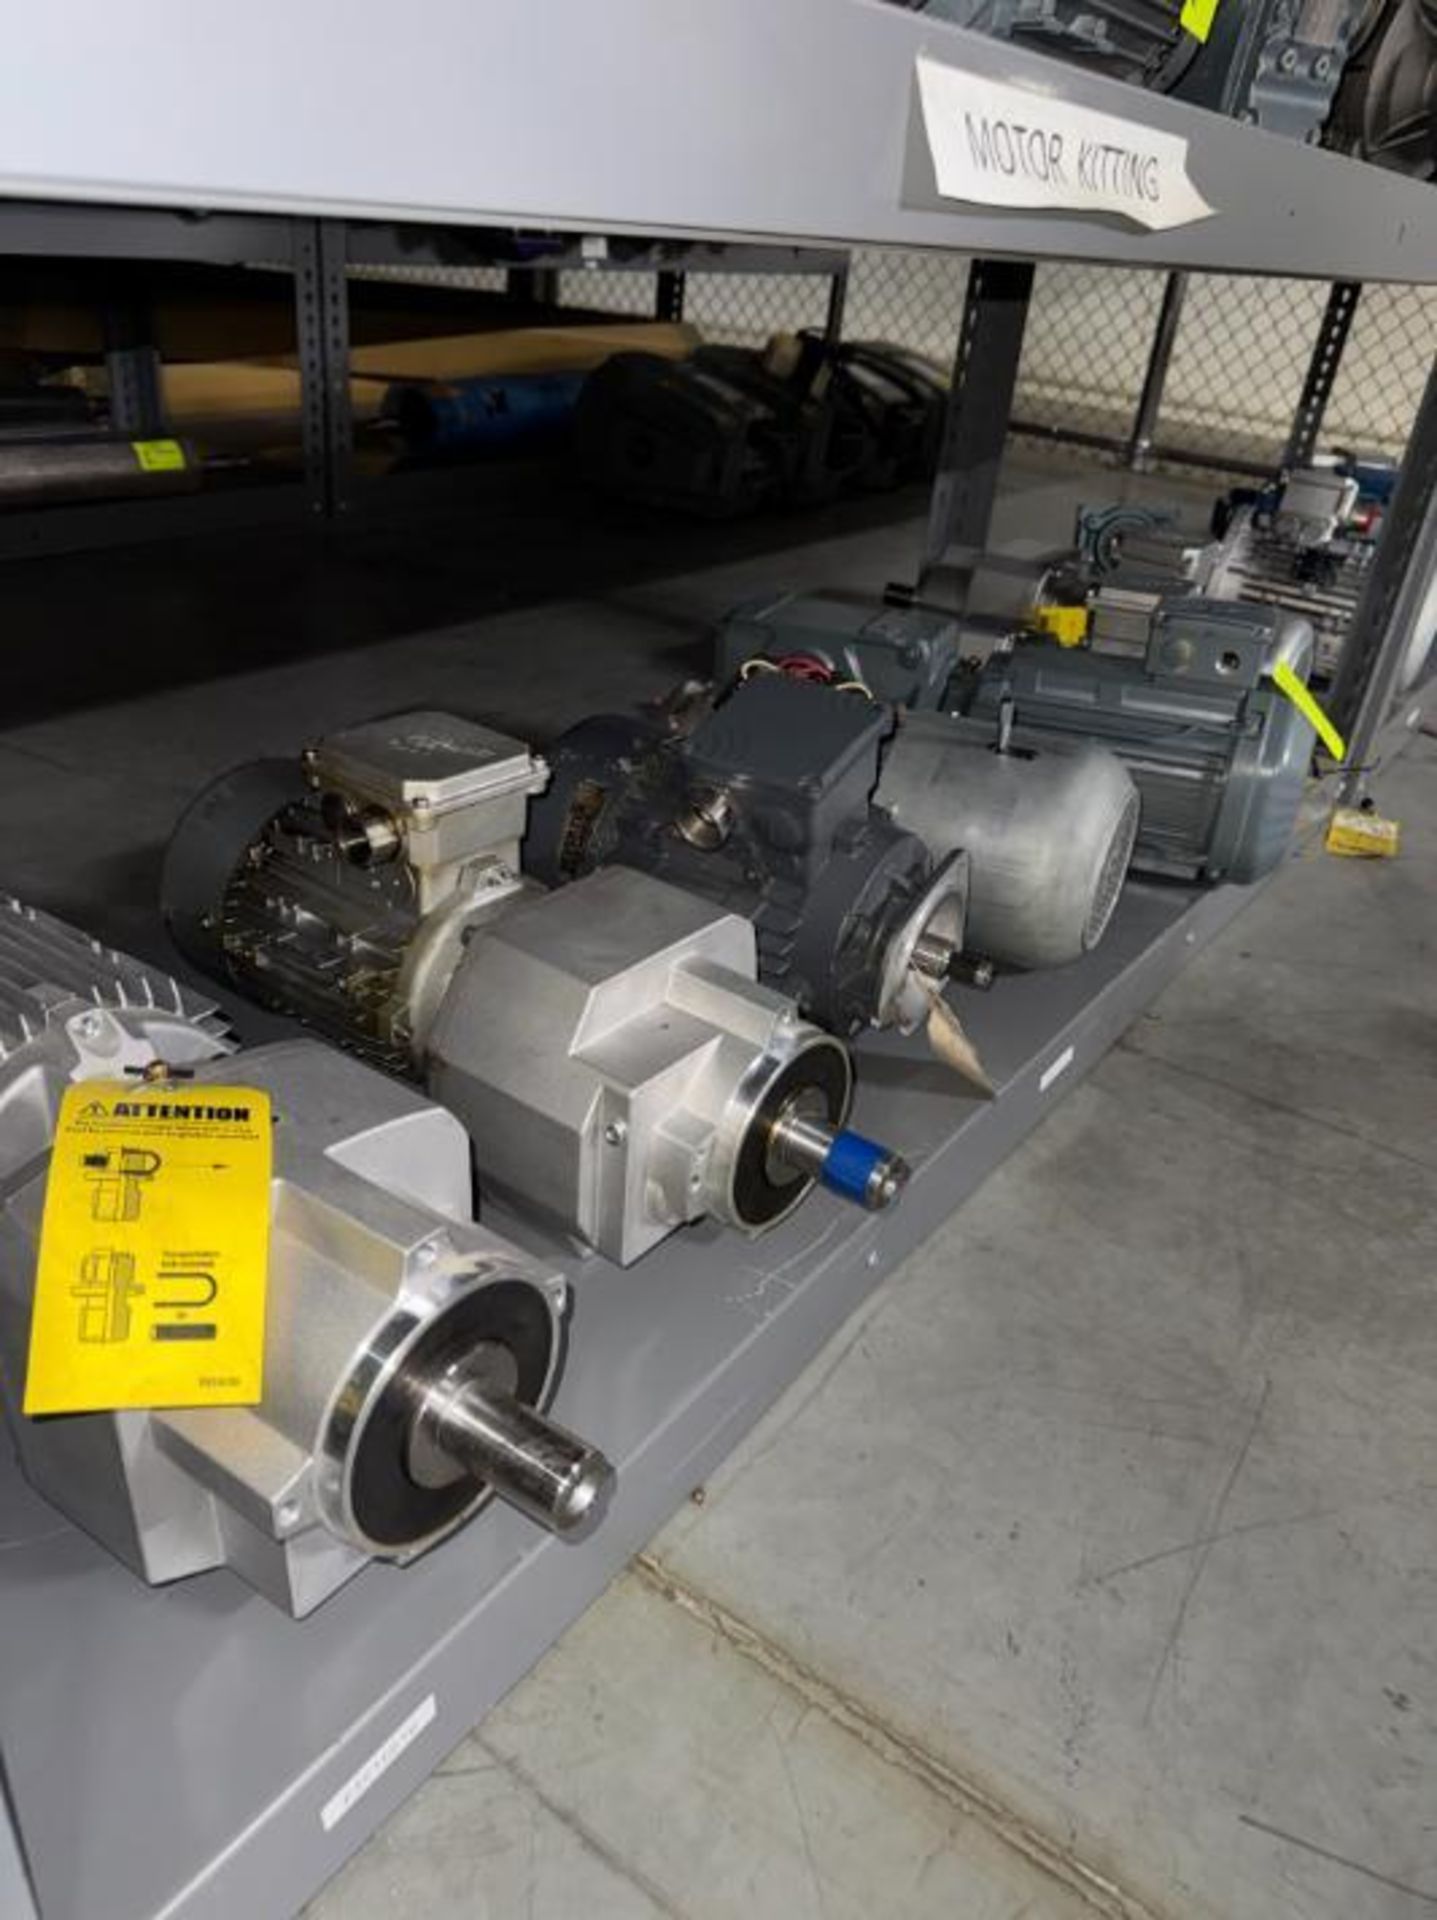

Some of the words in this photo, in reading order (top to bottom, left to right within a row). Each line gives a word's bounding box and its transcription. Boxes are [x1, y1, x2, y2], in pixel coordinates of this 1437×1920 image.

[963, 112, 1067, 184] MOTOR
[1078, 138, 1160, 201] KITTING
[113, 1102, 249, 1121] ATTENTION
